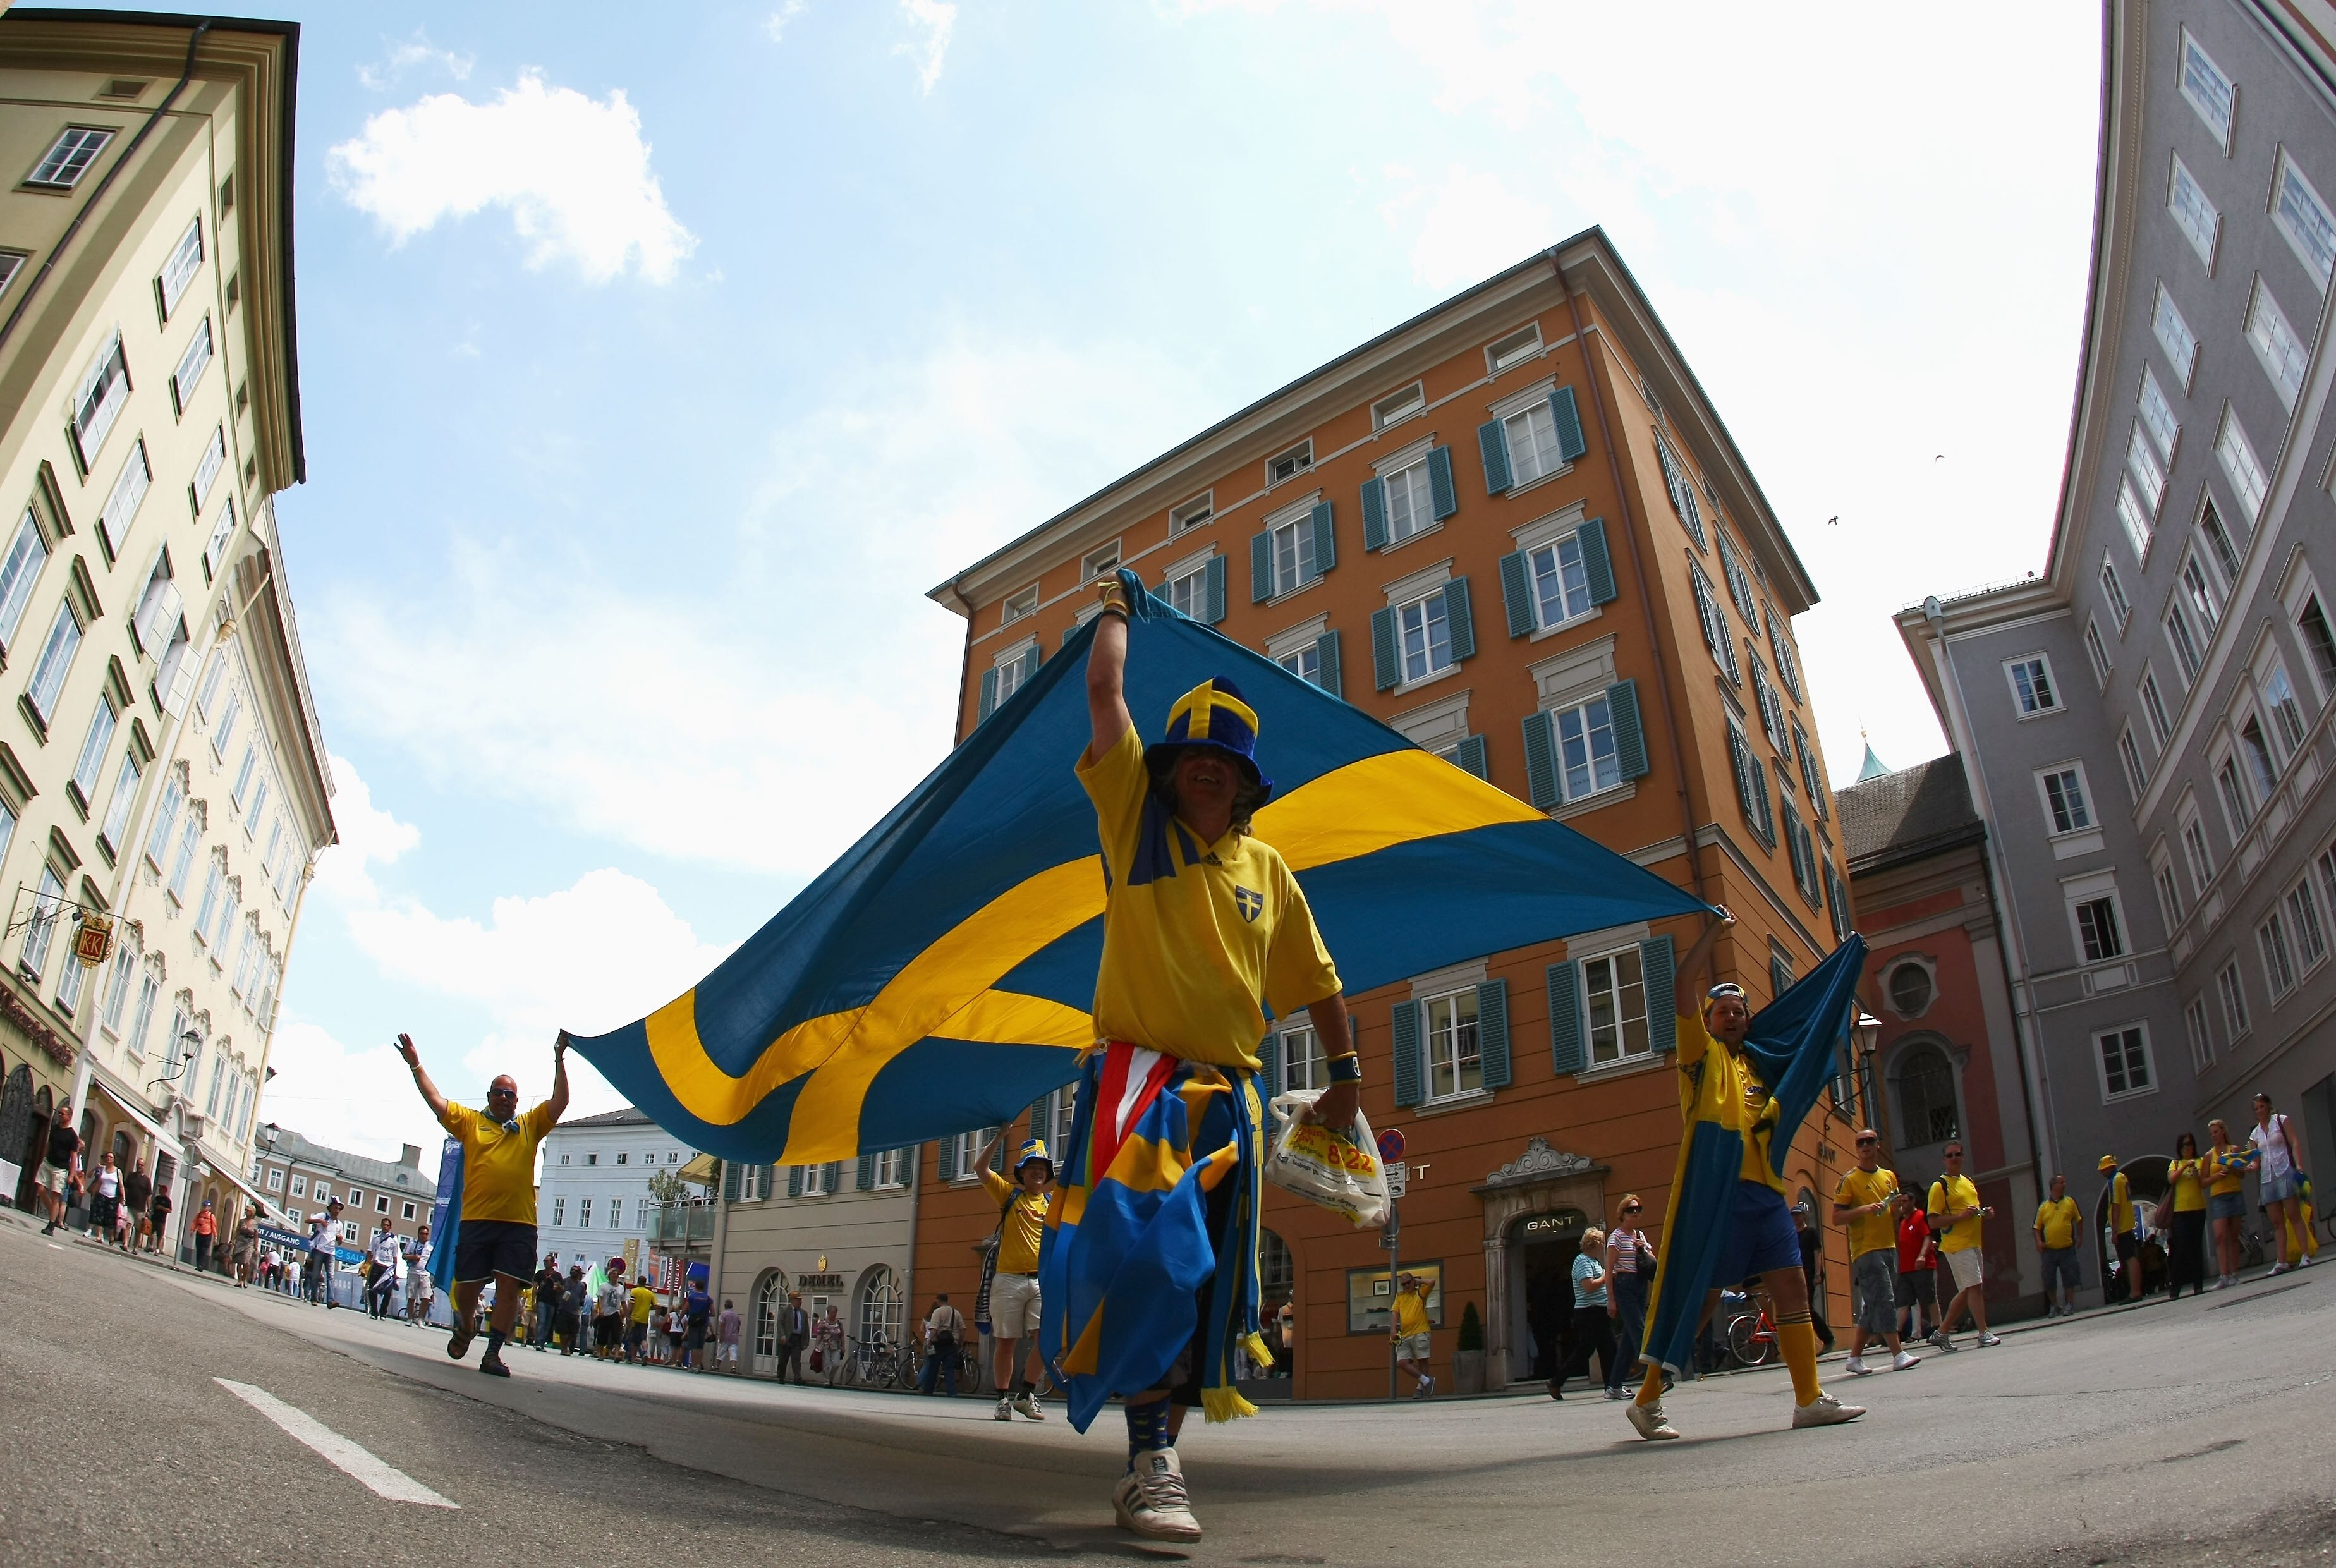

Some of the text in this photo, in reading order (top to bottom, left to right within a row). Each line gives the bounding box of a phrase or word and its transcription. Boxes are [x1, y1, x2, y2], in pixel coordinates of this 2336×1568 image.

[1527, 1215, 1575, 1230] GANT
[269, 1232, 300, 1246] AUSGANG
[347, 1253, 365, 1263] SALZ
[798, 1274, 844, 1287] DEMEL
